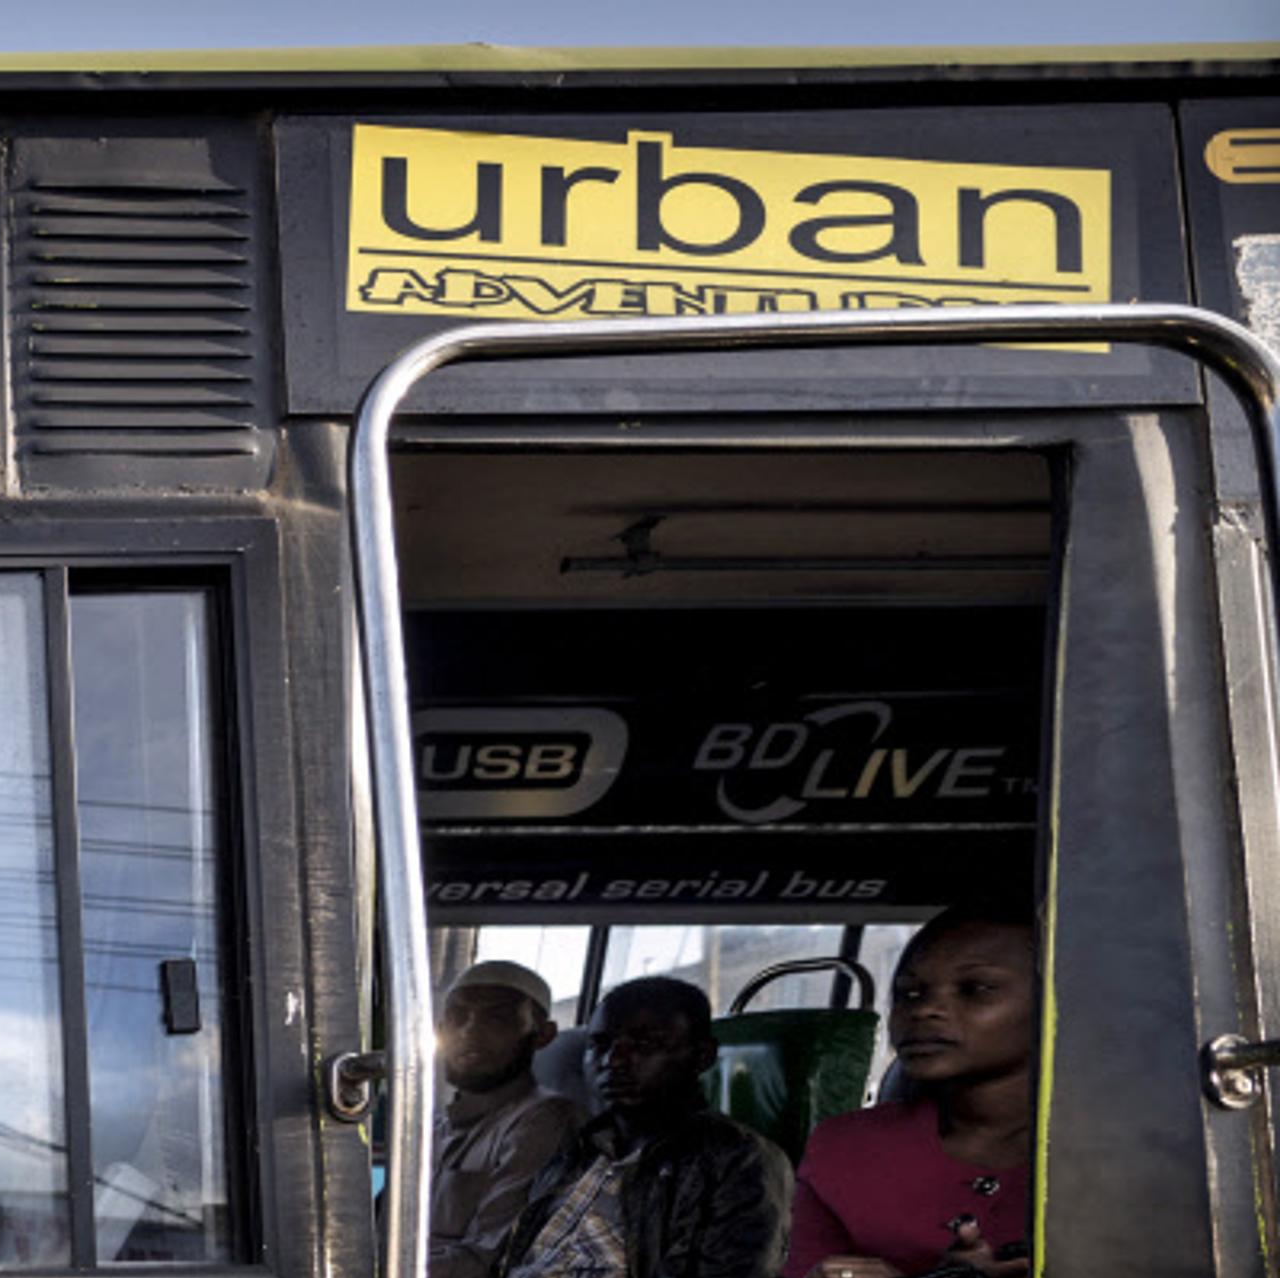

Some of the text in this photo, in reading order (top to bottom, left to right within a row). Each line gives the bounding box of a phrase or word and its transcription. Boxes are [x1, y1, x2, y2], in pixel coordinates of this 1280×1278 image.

[380, 140, 1085, 273] urban
[359, 266, 1064, 316] ADVENT
[421, 744, 578, 780] USB
[694, 722, 807, 771] BD
[800, 745, 1005, 799] LIVE
[600, 870, 768, 901] serial
[779, 870, 888, 900] bus
